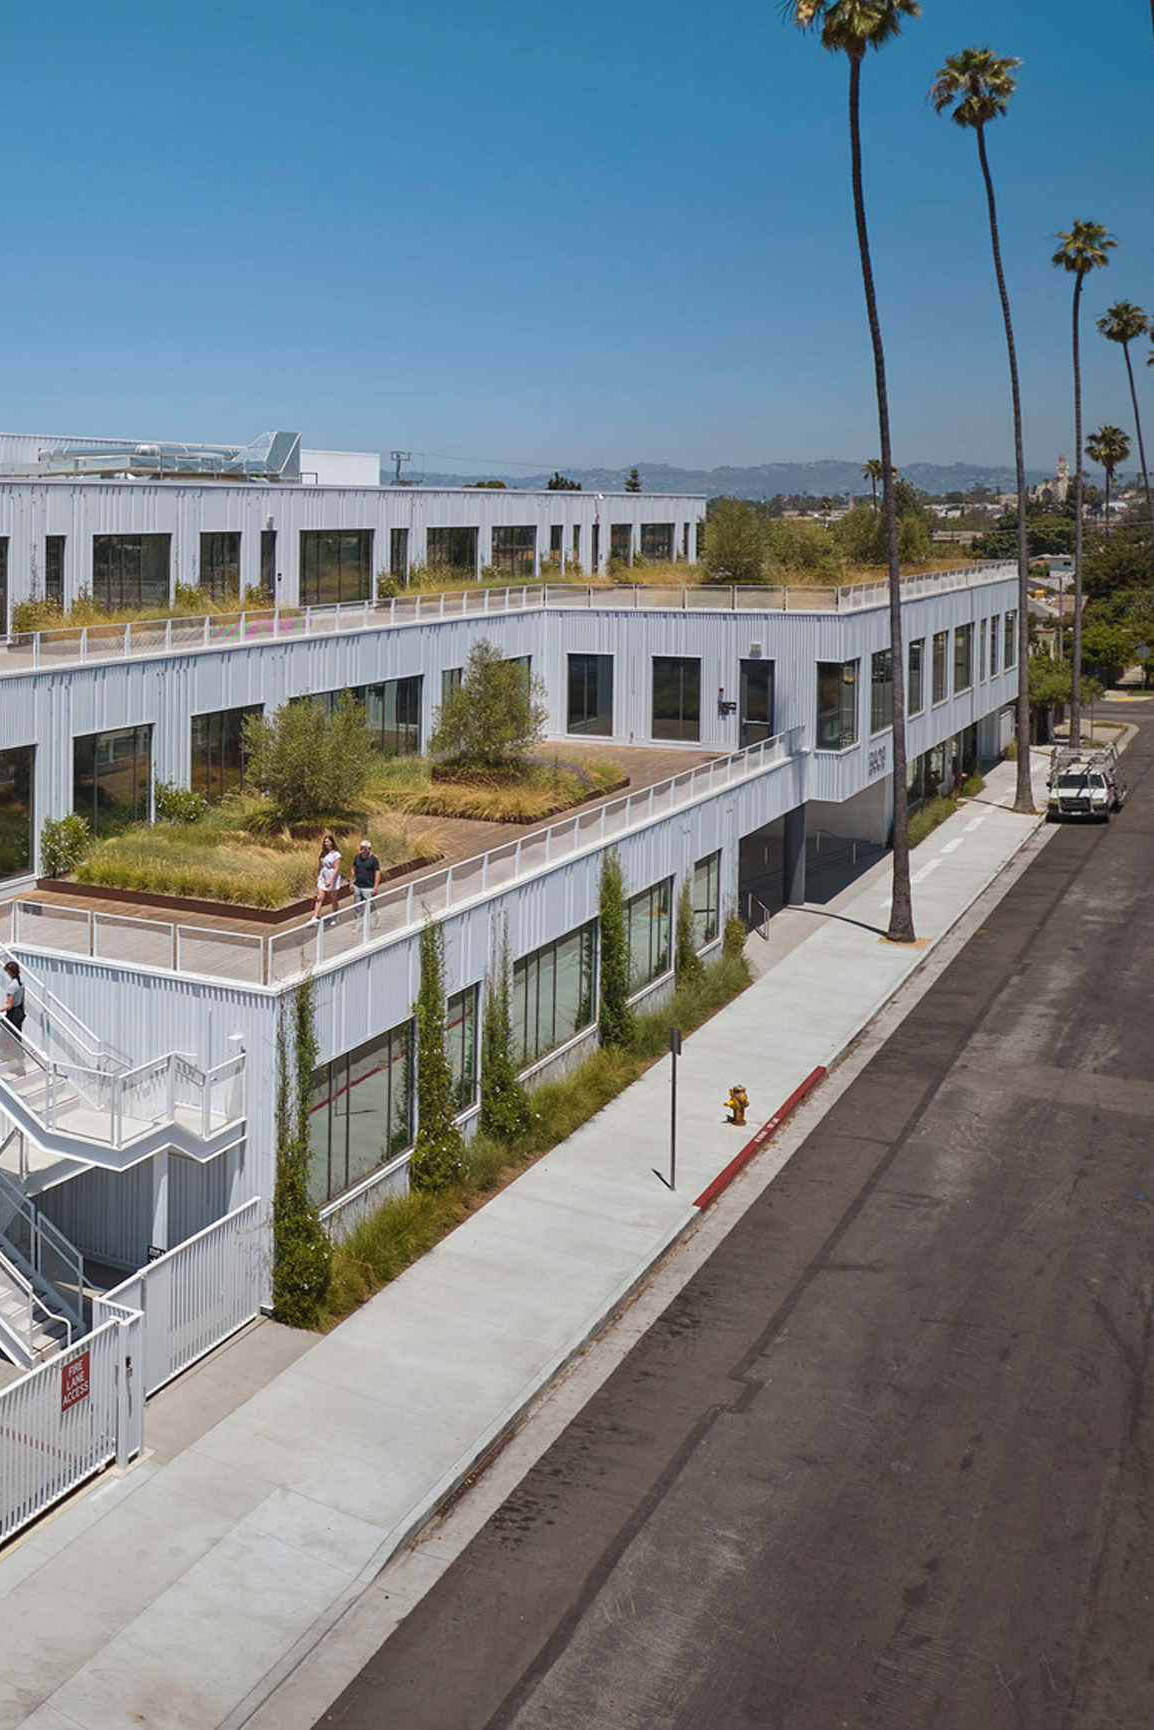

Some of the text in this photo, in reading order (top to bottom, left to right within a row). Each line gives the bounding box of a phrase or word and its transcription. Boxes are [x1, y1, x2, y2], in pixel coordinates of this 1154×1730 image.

[69, 1359, 83, 1377] FIRE
[67, 1370, 85, 1391] LANE
[63, 1381, 89, 1406] ACCESS
